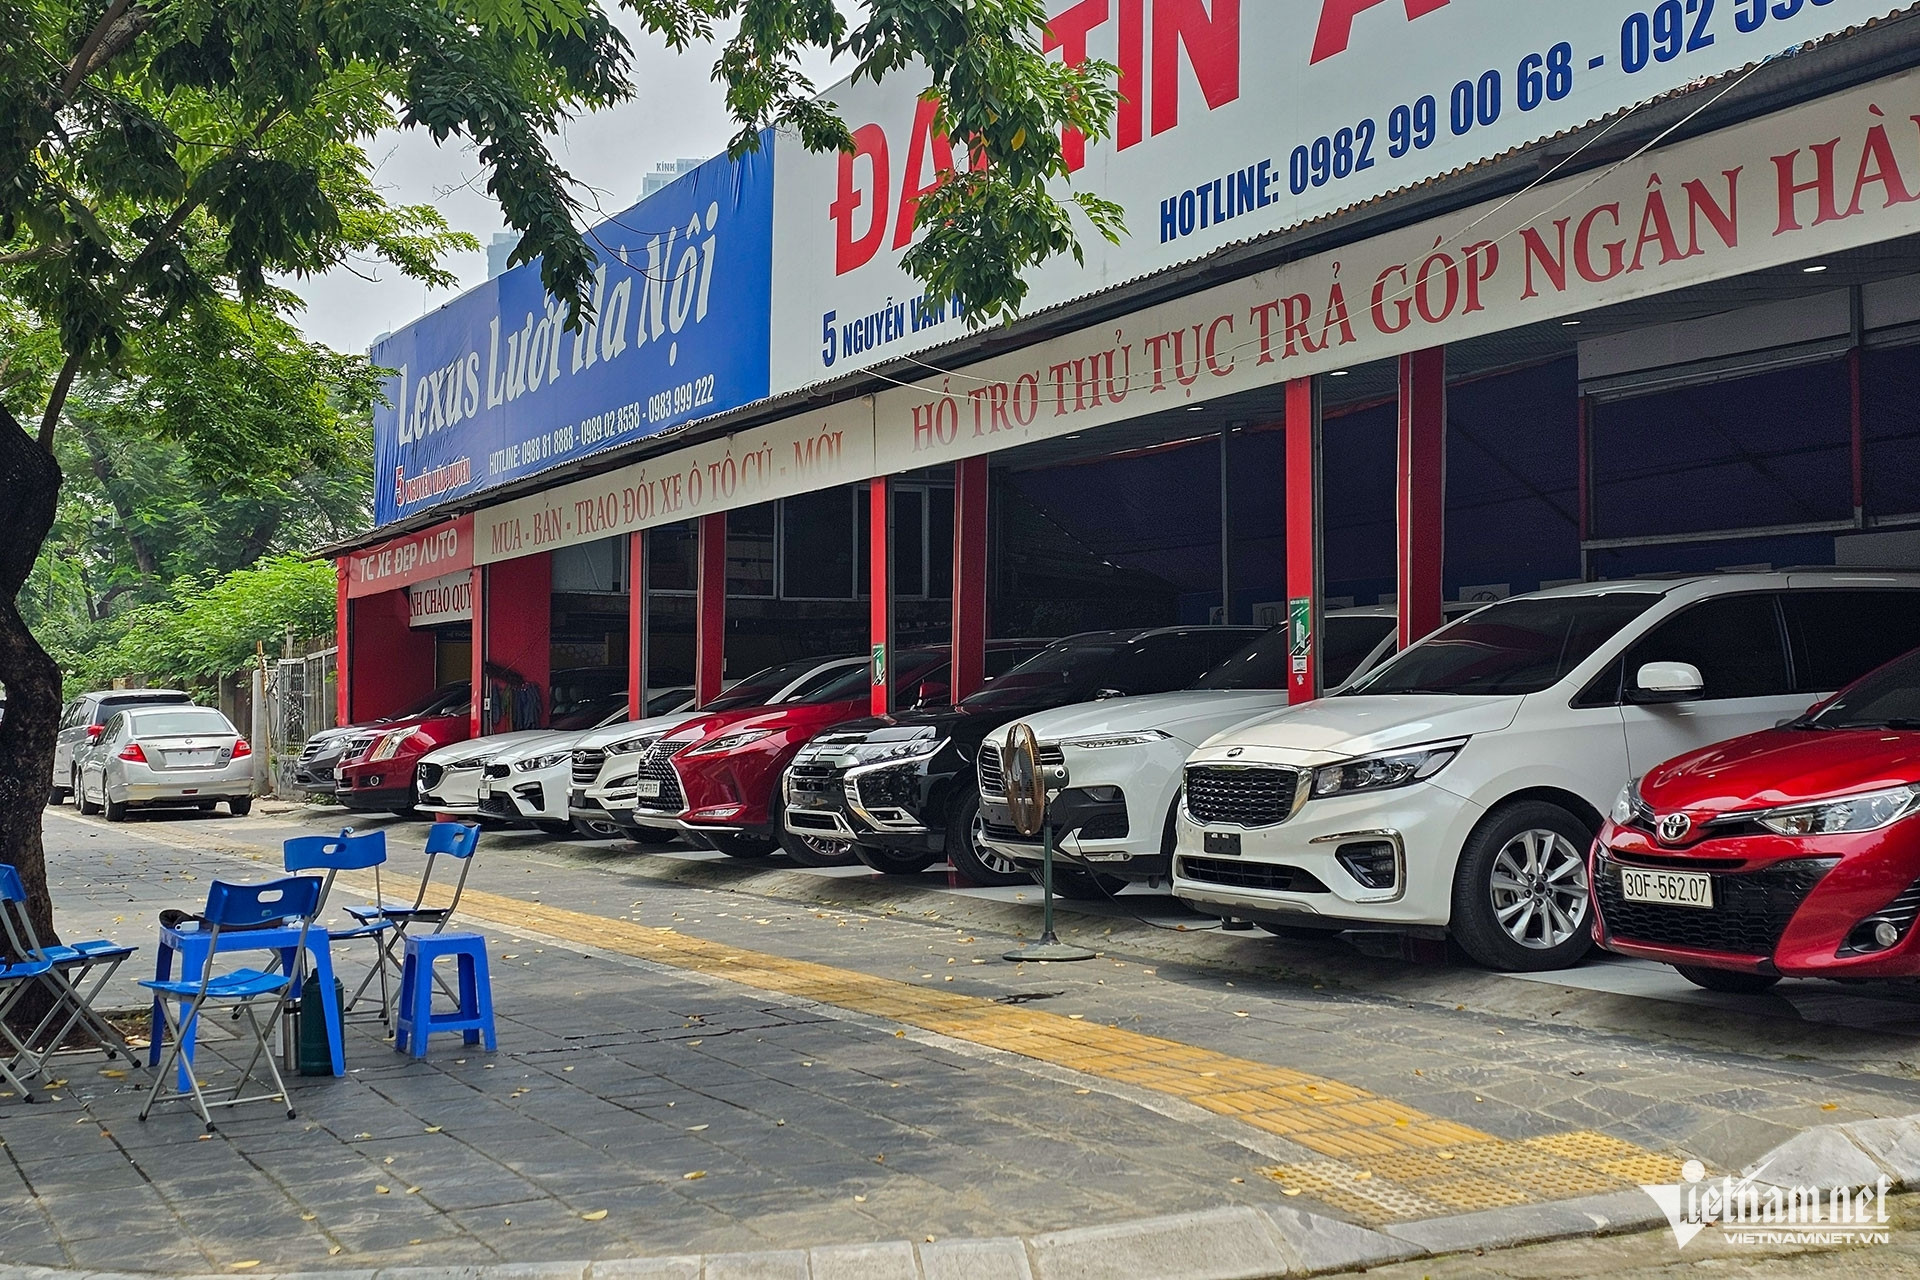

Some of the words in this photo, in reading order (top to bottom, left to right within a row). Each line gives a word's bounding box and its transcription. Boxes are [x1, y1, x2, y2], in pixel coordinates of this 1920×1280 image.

[1160, 159, 1279, 243] HOTLINE:
[1289, 118, 1375, 196] 0982
[1388, 94, 1436, 159] 99
[1450, 69, 1500, 136] 00
[1516, 41, 1573, 112] 68
[1620, 0, 1714, 74] 092
[912, 376, 959, 453] HỖ
[1049, 328, 1132, 417] THỦ
[1144, 314, 1235, 399] TỤC
[1250, 260, 1357, 367] TRẢ
[1371, 235, 1499, 335] GÓP
[1519, 165, 1744, 301] NGÂN
[1772, 104, 1920, 238] HÀ
[399, 352, 479, 447] Lexus
[638, 201, 718, 366] Nội
[823, 310, 837, 368] 5
[842, 296, 905, 359] NGUYỄN
[489, 448, 520, 476] HOTLINE:
[522, 437, 540, 465] 0988
[542, 432, 551, 458] 81
[554, 425, 573, 454] 8888
[581, 414, 602, 445] 0989
[604, 410, 615, 437] 02
[617, 402, 640, 433] 8558
[648, 390, 671, 423] 0983
[674, 382, 692, 415] 999
[694, 373, 715, 408] 222
[396, 465, 405, 507] 5
[491, 518, 522, 555] MUA
[533, 502, 562, 546] BÁN
[574, 492, 618, 536] TRAO
[622, 469, 656, 525] ĐỔI
[660, 473, 683, 515] XE
[688, 459, 703, 507] Ô
[708, 449, 737, 503] TÔ
[360, 555, 375, 583] TC
[377, 549, 392, 579] XE
[394, 542, 417, 577] ĐẸP
[420, 527, 458, 566] AUTO
[424, 579, 450, 615] CHÀO
[1625, 873, 1707, 903] 30F-562.07
